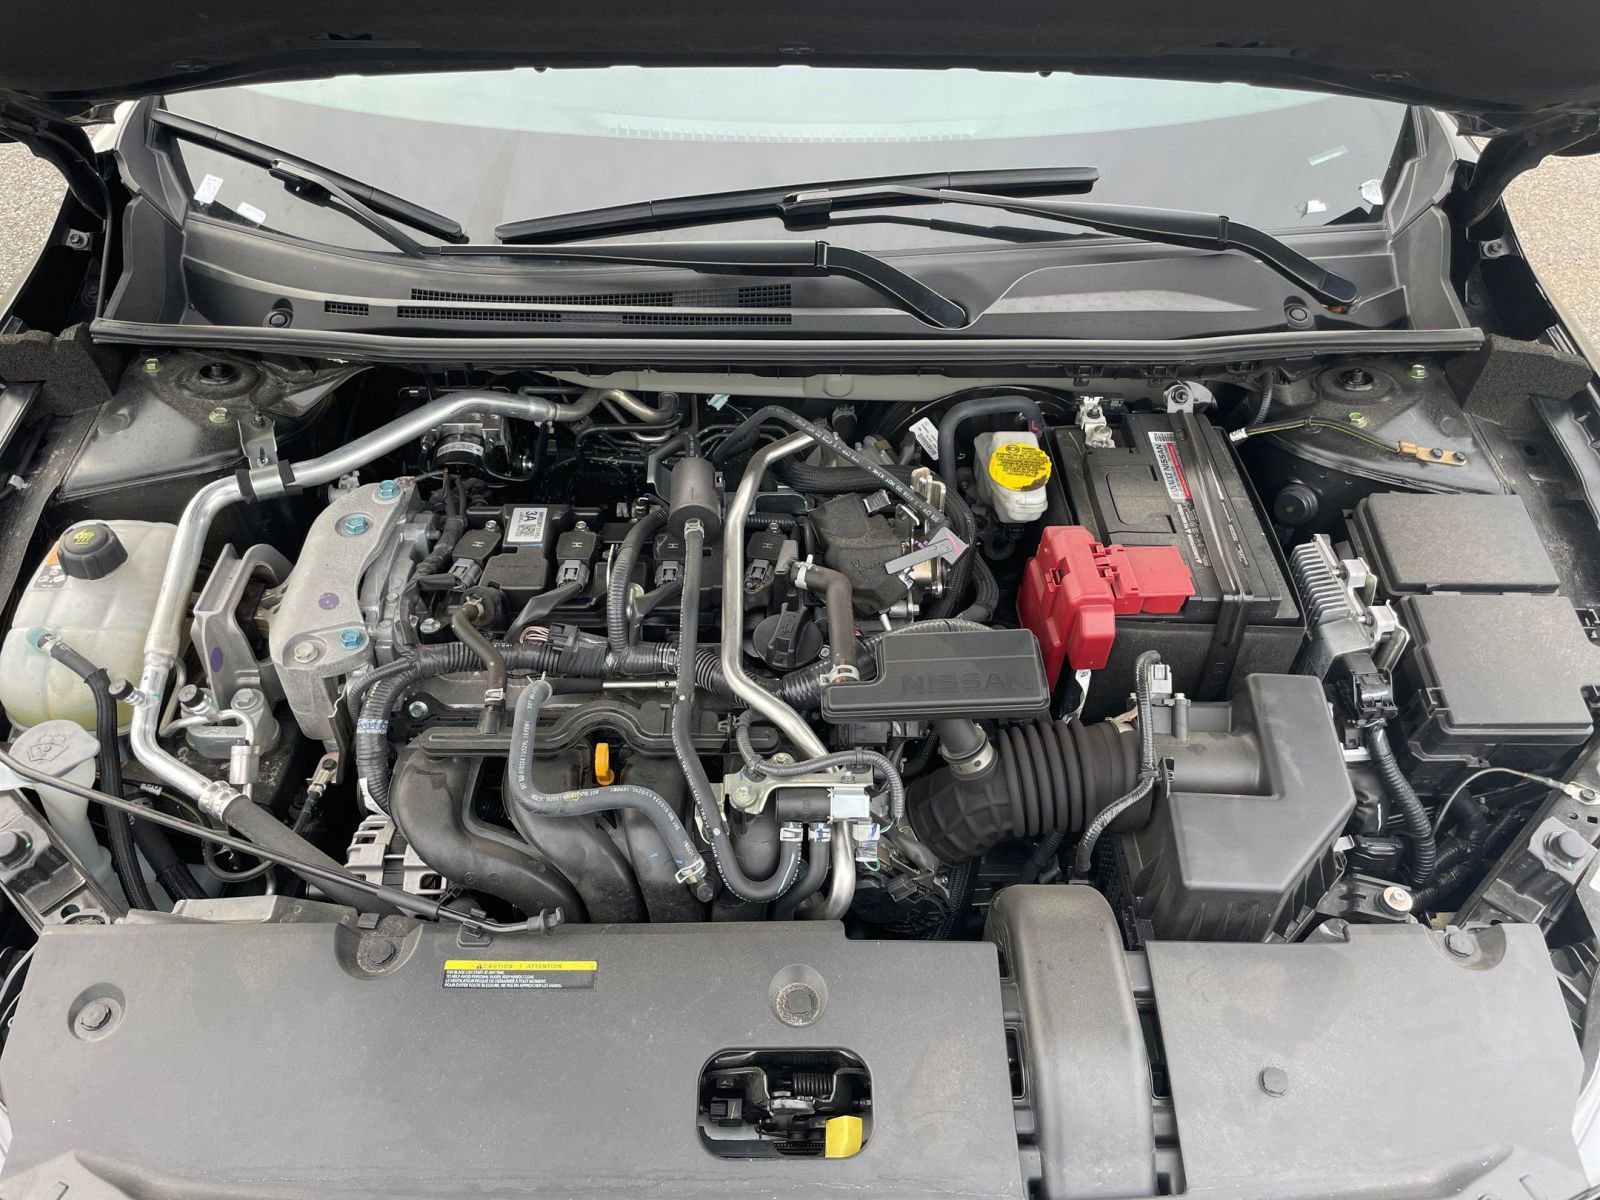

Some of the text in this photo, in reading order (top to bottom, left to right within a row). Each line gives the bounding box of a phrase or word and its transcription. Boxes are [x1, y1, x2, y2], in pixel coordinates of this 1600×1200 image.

[1155, 443, 1170, 471] NISSAN
[524, 510, 538, 522] 3A
[902, 672, 1033, 694] NISSAN
